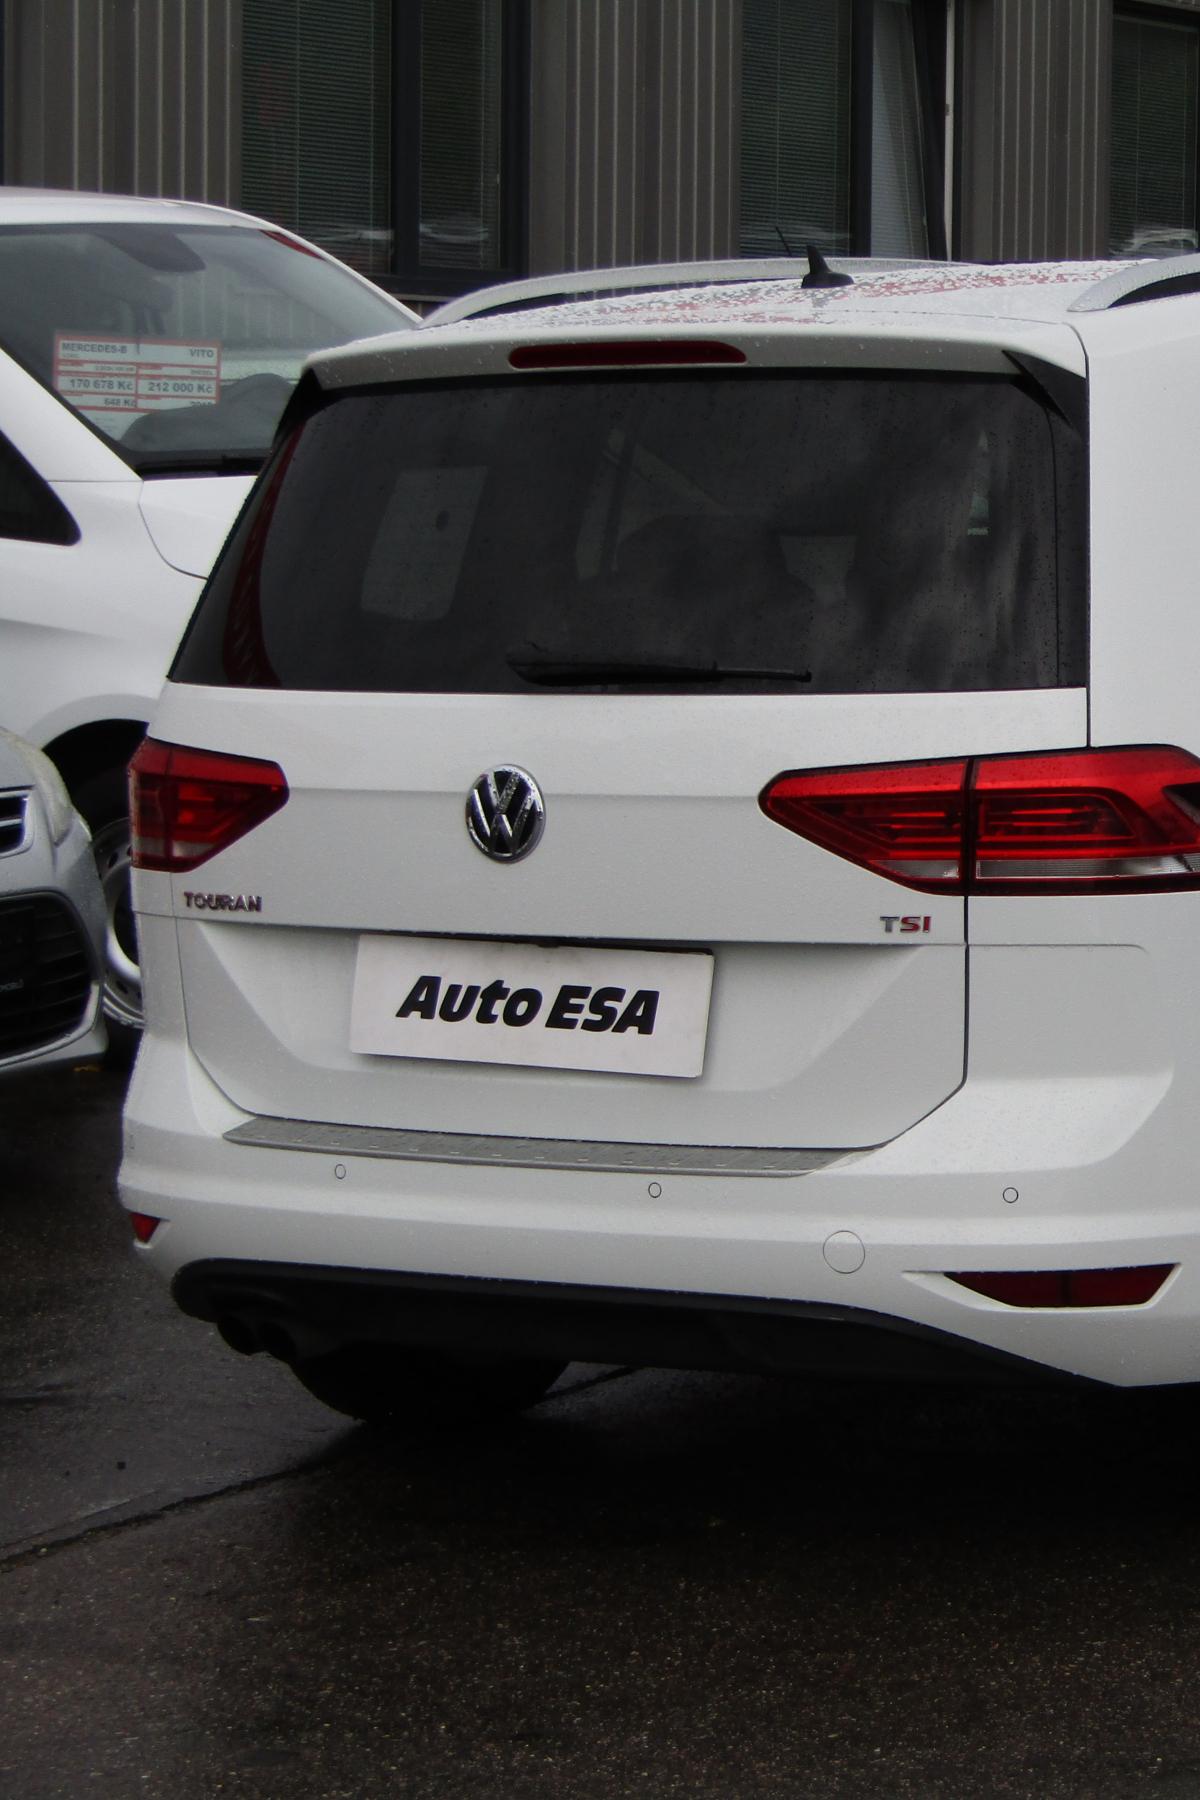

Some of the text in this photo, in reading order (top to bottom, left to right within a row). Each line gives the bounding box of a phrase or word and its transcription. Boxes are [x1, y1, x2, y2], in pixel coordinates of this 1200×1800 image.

[62, 342, 127, 354] MERCEDES-B
[190, 348, 214, 358] VITO
[70, 379, 90, 390] 170
[148, 382, 170, 392] 212
[173, 382, 194, 393] 000
[183, 891, 262, 912] TOURAN
[880, 916, 931, 933] TSI
[395, 975, 660, 1035] Auto ESA
